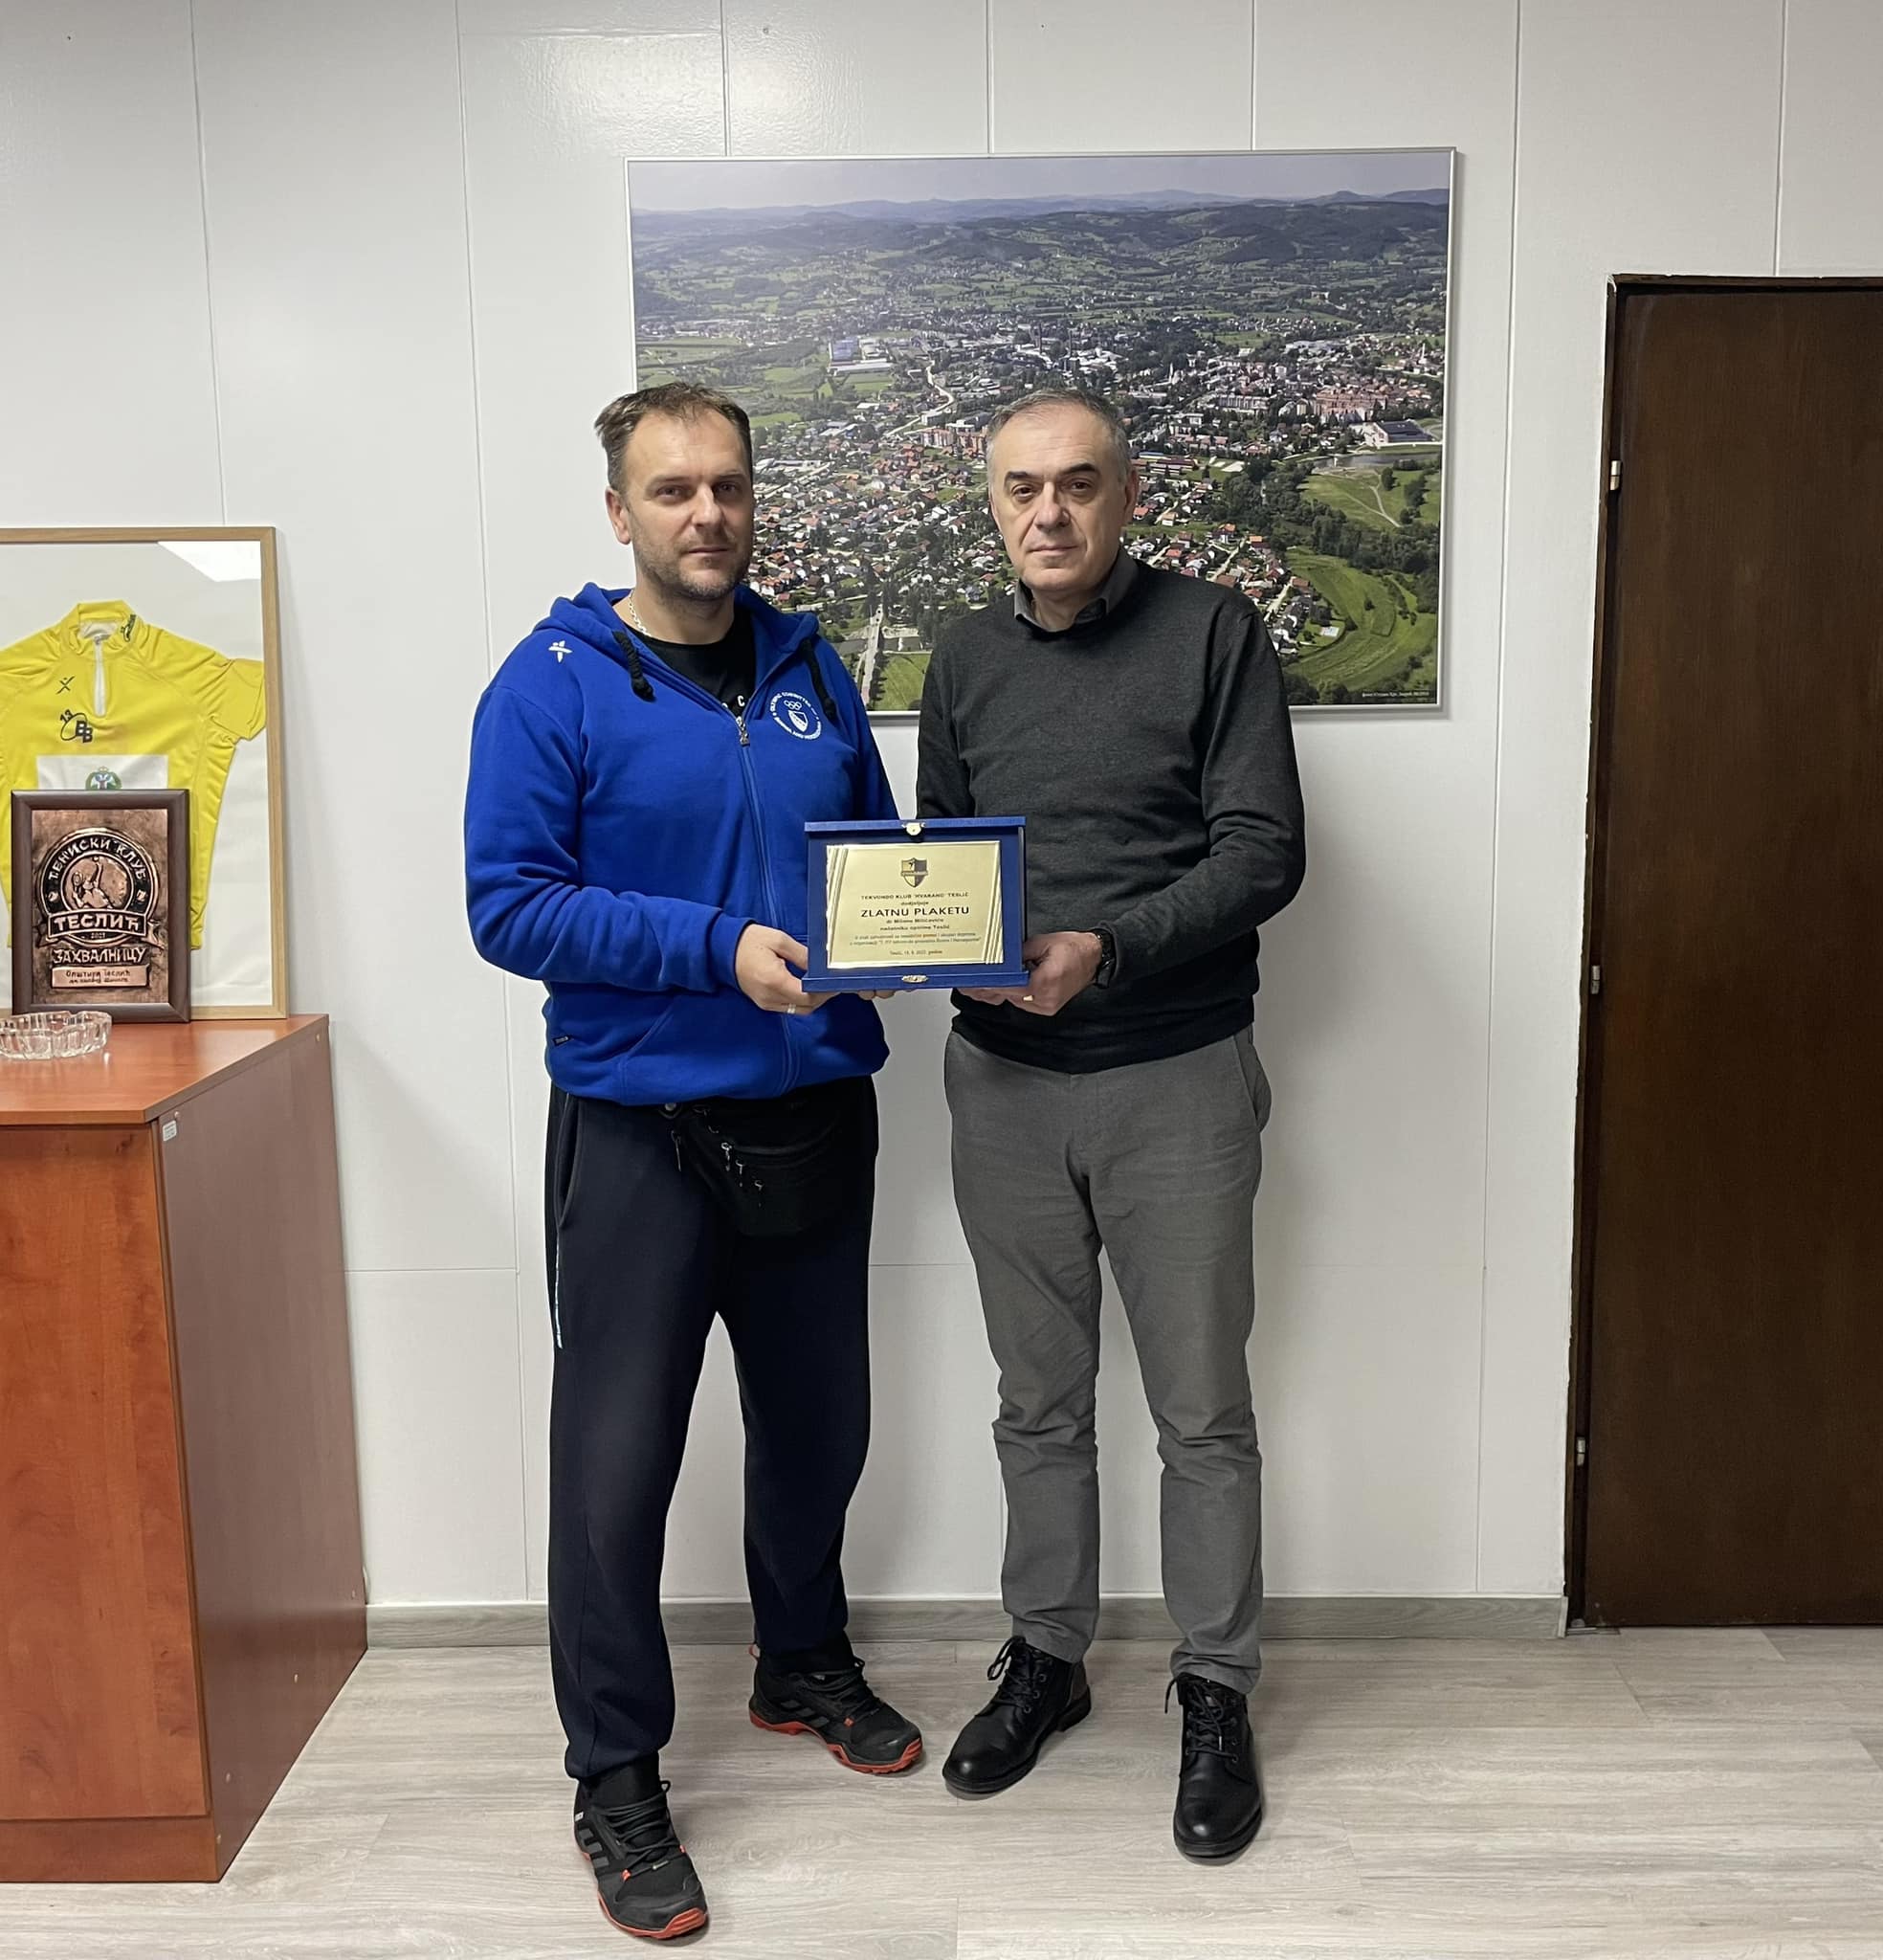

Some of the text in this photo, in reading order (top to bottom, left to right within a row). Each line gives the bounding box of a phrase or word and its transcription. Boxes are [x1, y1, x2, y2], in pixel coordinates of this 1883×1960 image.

[48, 837, 146, 880] ТЕНИСКИ КЛУБ
[860, 906, 969, 917] ZLATNU PLAKETU
[54, 913, 139, 931] ТЕСЛИЋ
[53, 947, 147, 964] ЗАХВАЛНИЦУ
